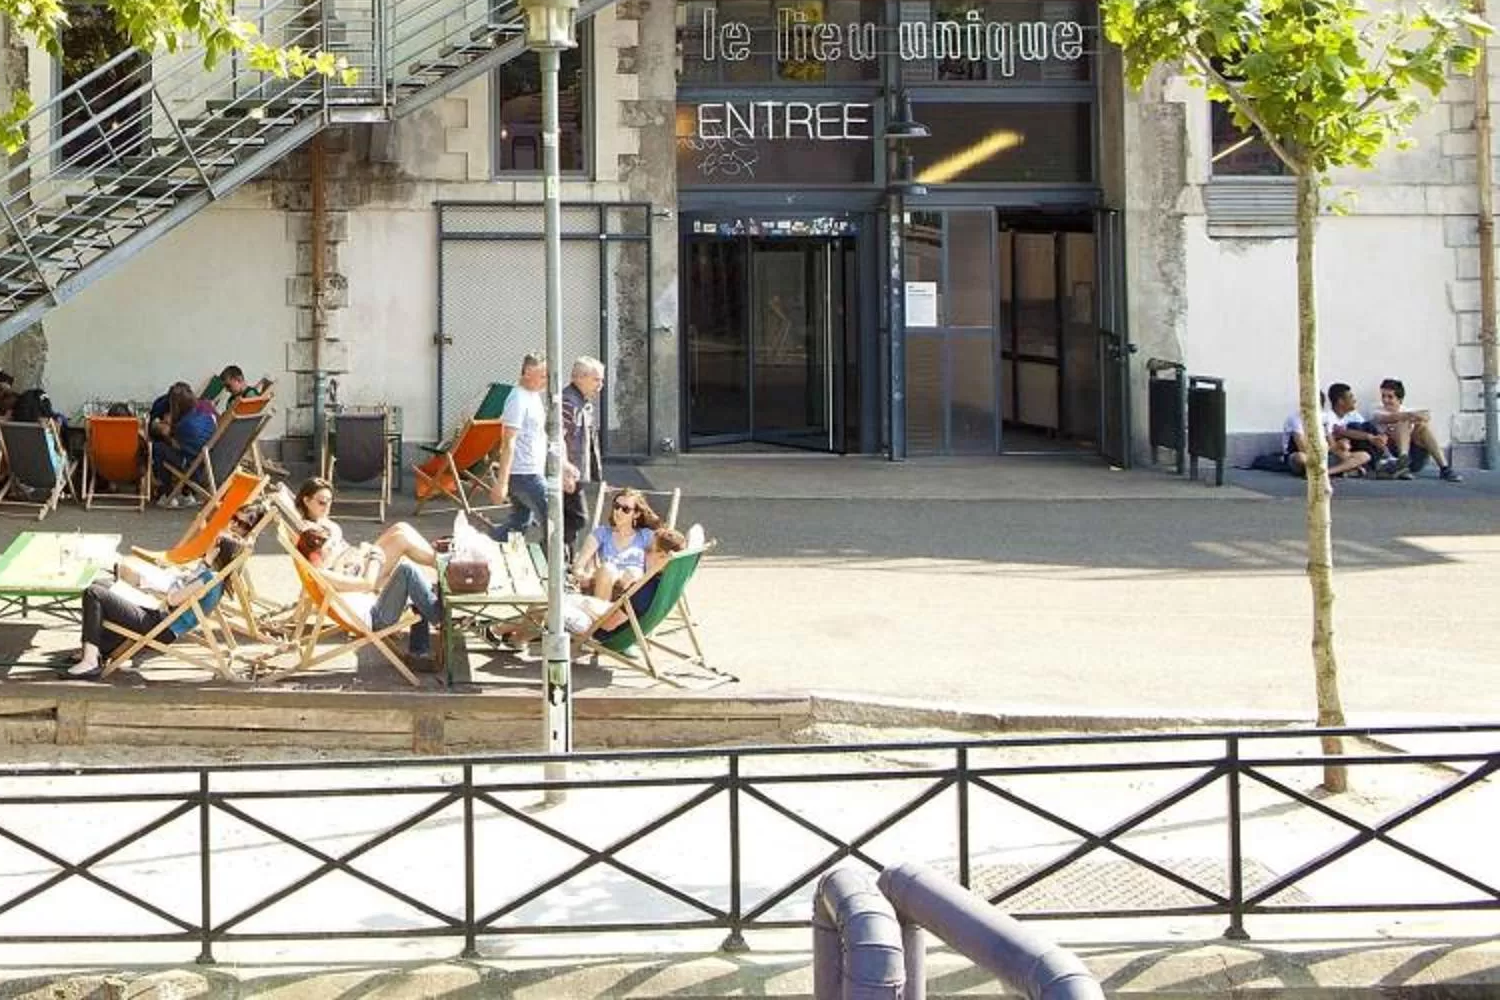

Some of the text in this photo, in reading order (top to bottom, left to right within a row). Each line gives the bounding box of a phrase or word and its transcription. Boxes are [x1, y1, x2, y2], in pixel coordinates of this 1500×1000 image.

[703, 7, 1083, 76] le lieu unique
[698, 101, 869, 141] ENTREE
